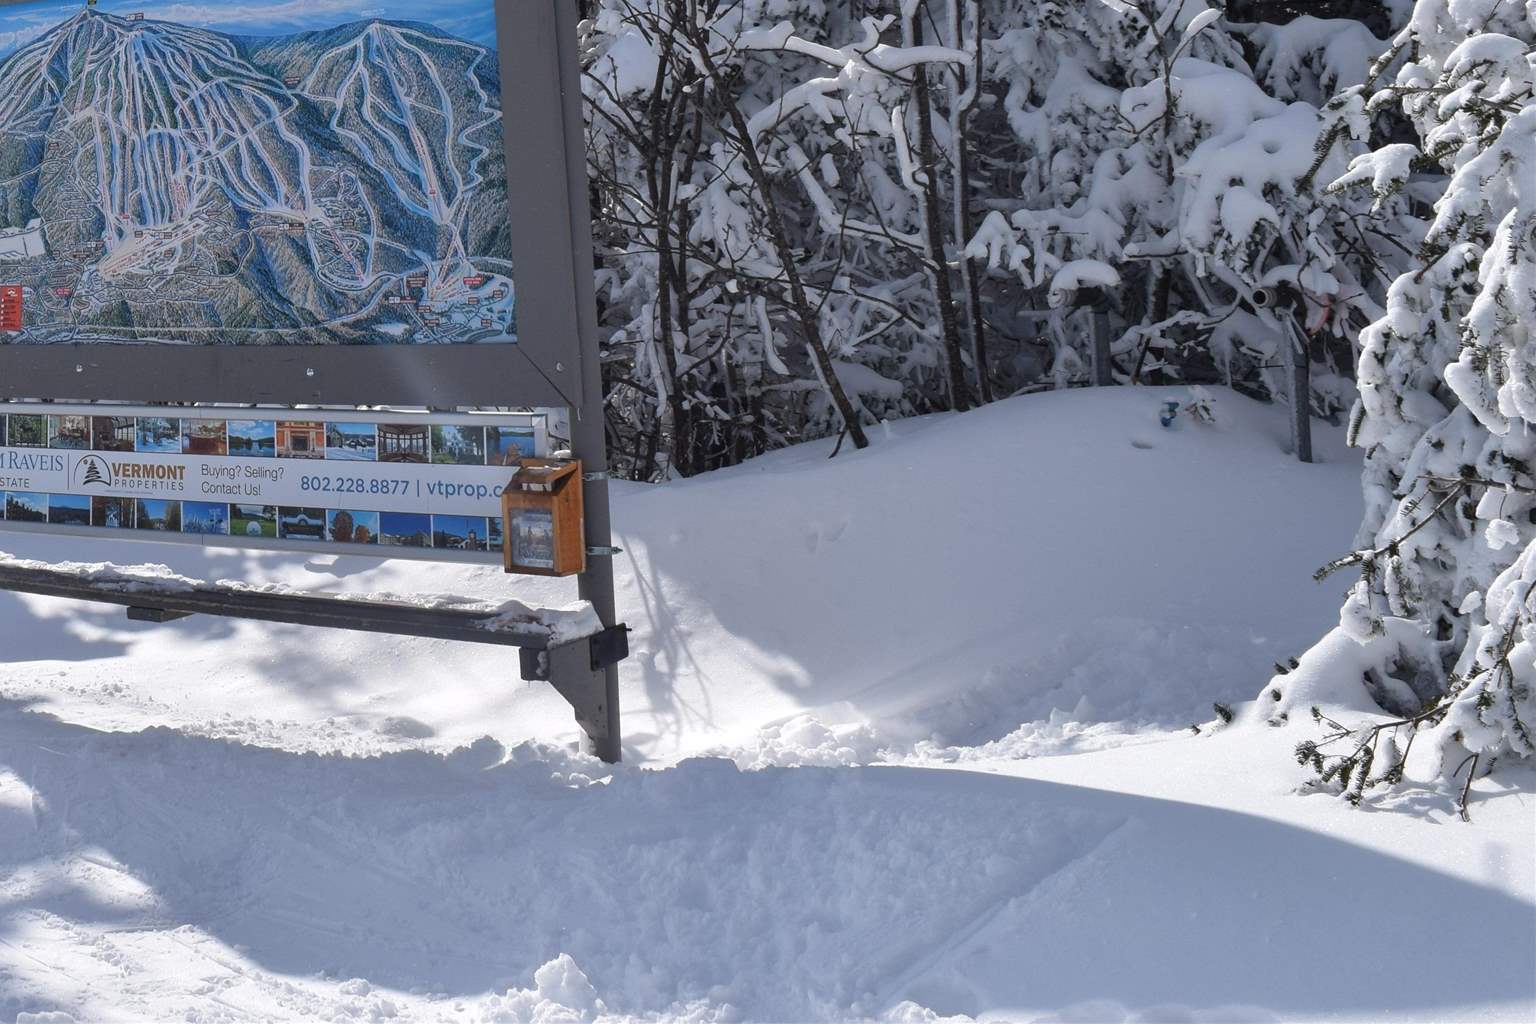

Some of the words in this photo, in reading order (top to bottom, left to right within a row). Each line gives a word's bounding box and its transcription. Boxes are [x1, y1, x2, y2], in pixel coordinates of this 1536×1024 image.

[8, 449, 64, 472] RAVEIS
[112, 462, 185, 480] VERMONT
[201, 464, 241, 481] Buying?
[244, 465, 284, 482] Selling?
[114, 479, 184, 491] PROPERTIES
[201, 481, 242, 495] Contact
[245, 483, 262, 496] Us!
[301, 475, 410, 496] 802.228.8877
